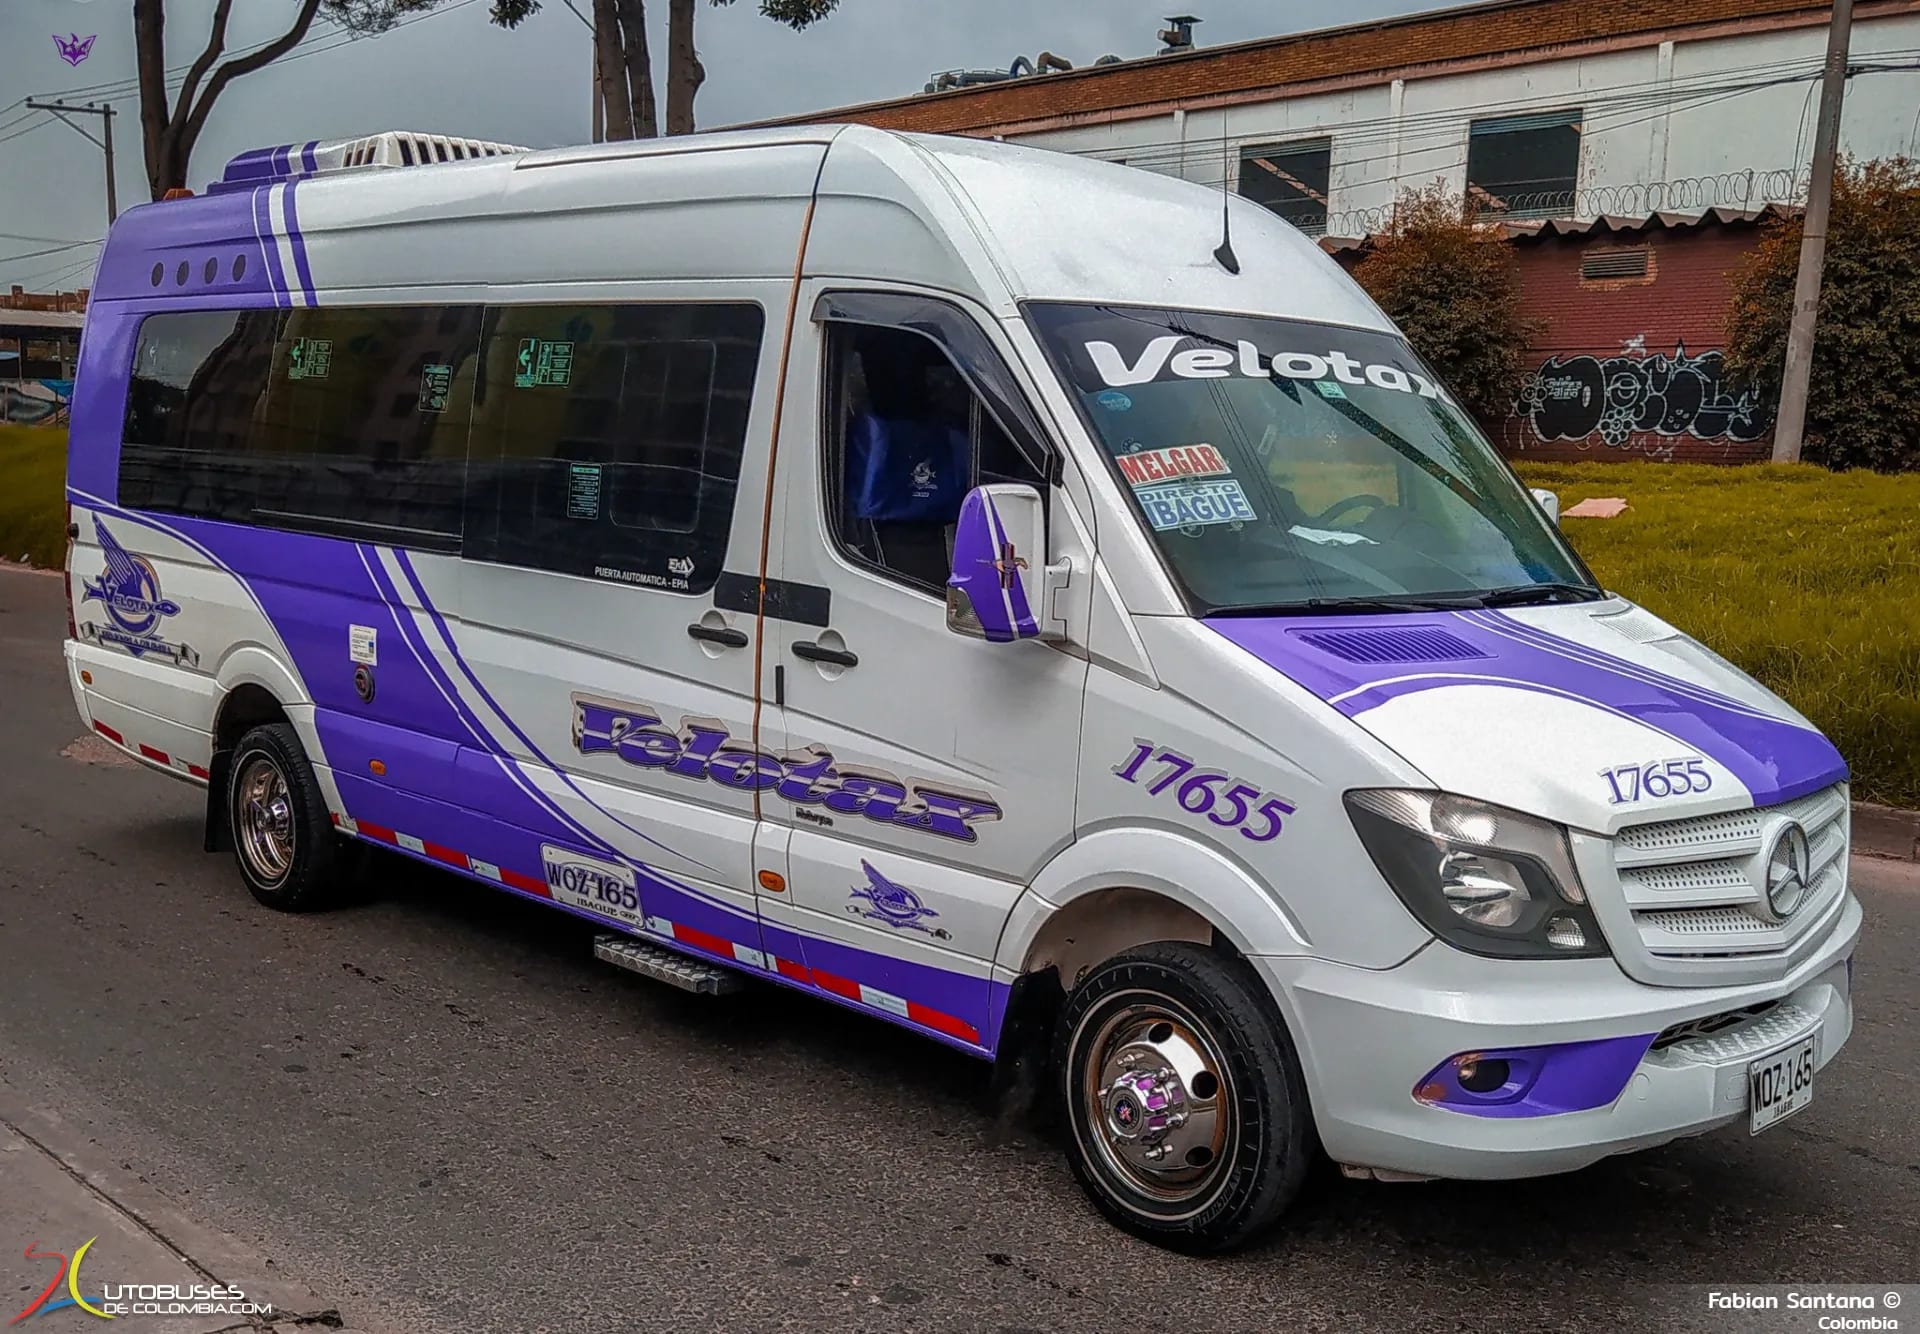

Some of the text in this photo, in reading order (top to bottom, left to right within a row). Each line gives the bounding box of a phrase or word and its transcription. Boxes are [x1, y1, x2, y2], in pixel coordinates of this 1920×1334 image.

[1084, 335, 1456, 406] Velotax
[1118, 447, 1224, 484] MELGAR
[1139, 485, 1237, 502] DIRECTO
[1144, 493, 1249, 526] IBAGUE
[96, 575, 154, 612] VELOTAX
[594, 566, 622, 579] PUERTA
[621, 571, 667, 588] AUTOMATICA
[572, 692, 1002, 842] Velotax
[1599, 758, 1712, 804] 17655
[1112, 740, 1297, 842] 17655
